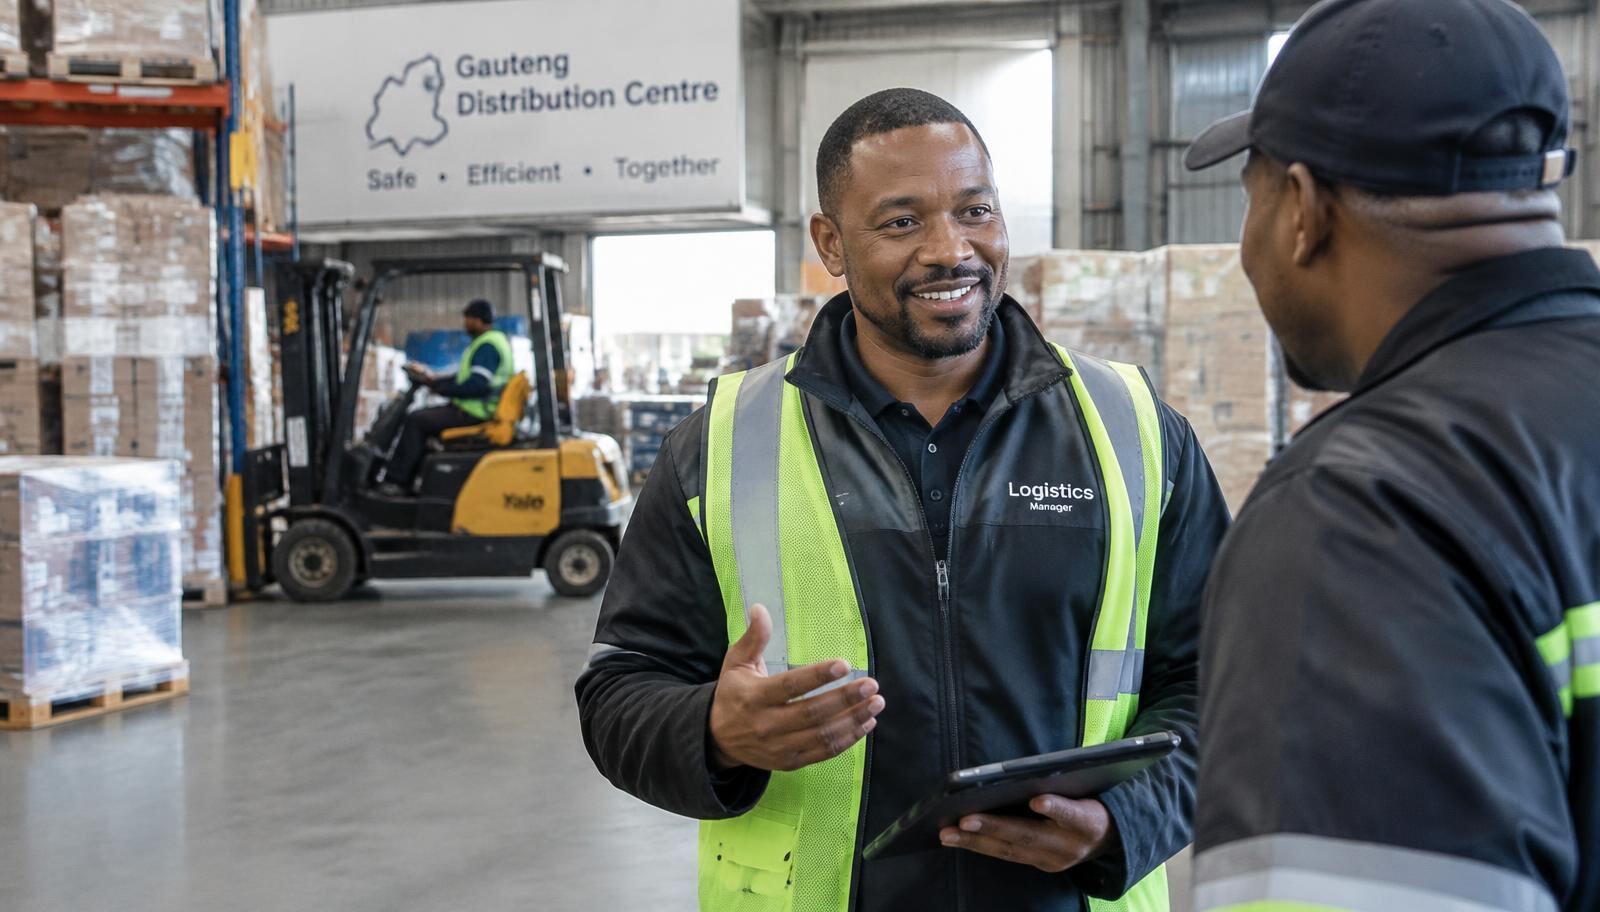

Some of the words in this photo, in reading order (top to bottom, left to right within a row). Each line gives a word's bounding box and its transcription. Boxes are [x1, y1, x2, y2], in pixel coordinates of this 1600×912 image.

[456, 53, 569, 79] Gauteng
[457, 86, 615, 117] Distribution
[624, 79, 719, 107] Centre
[367, 168, 417, 191] Safe
[467, 163, 561, 186] Efficient
[614, 155, 720, 184] Together
[1008, 481, 1095, 501] Logistics
[1029, 502, 1073, 513] Manager
